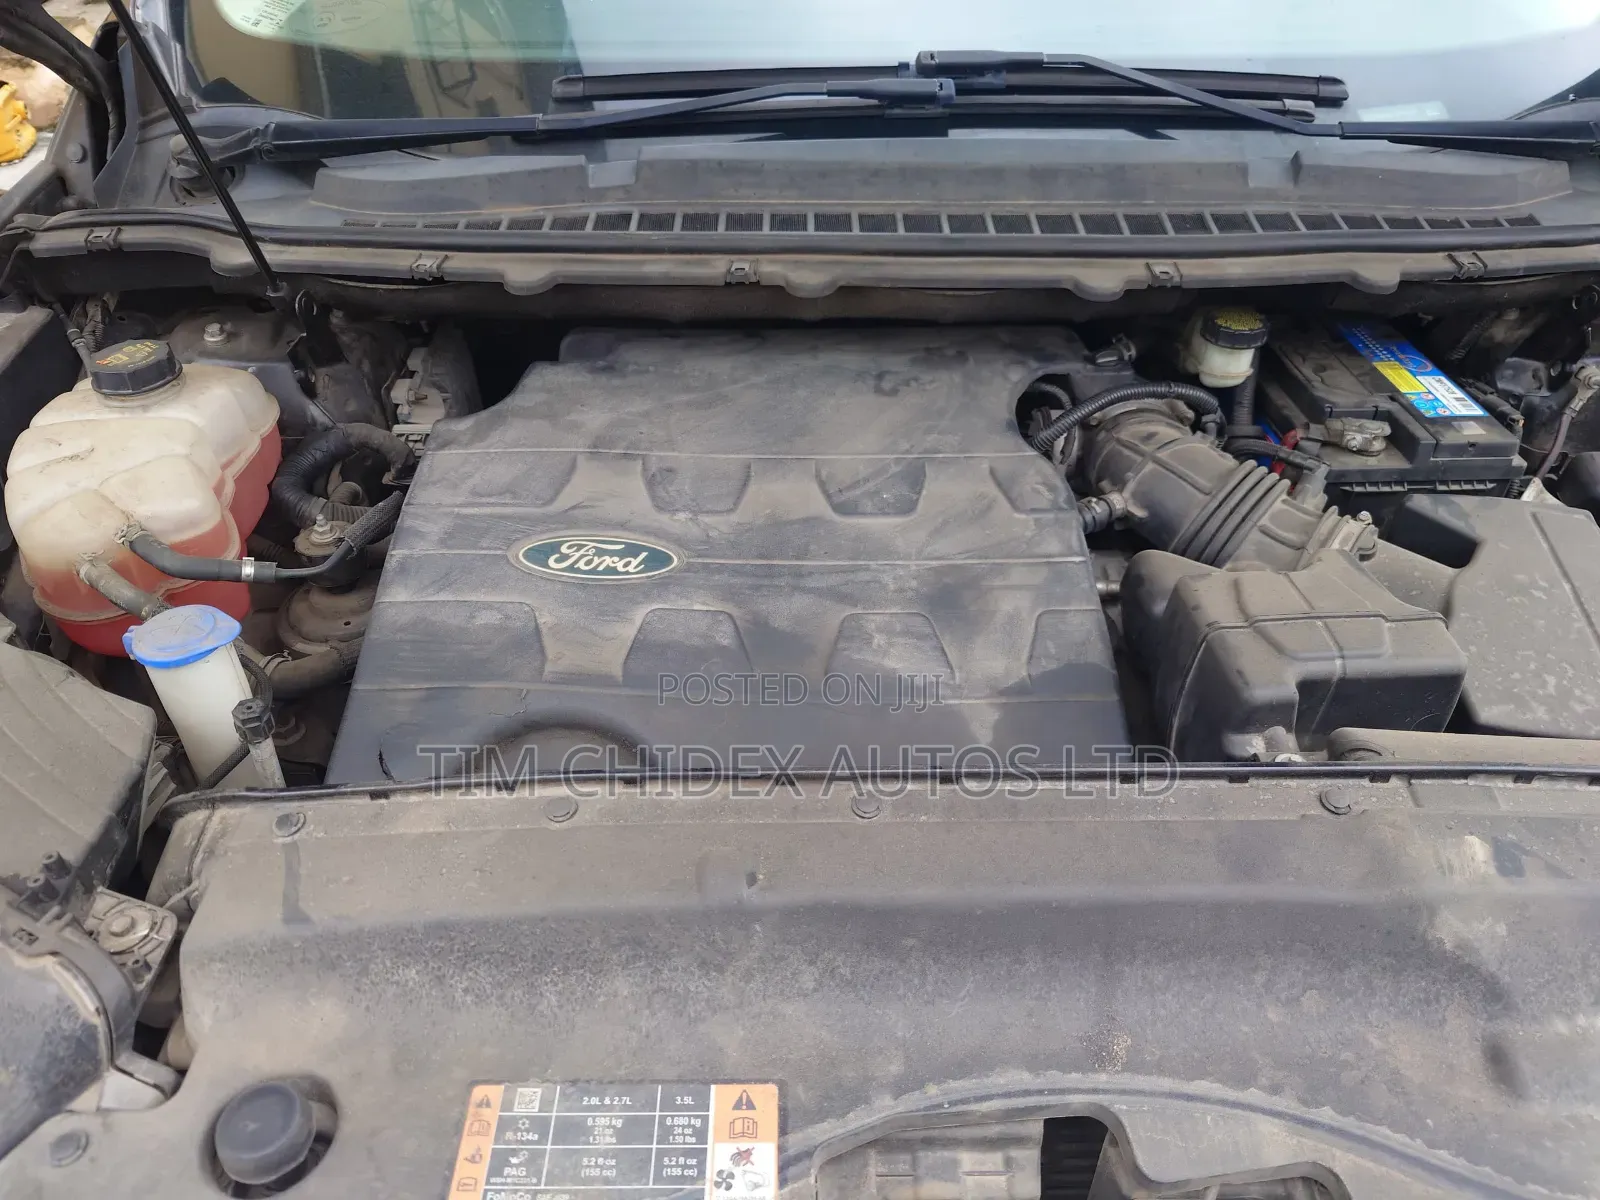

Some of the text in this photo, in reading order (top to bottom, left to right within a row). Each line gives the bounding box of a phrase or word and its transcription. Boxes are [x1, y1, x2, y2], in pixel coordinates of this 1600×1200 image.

[547, 540, 649, 573] Ford
[582, 1097, 632, 1105] 2.0L & 2.7L
[675, 1096, 695, 1105] 3.5L
[611, 1117, 623, 1128] kg
[665, 1117, 702, 1128] 0.680 kg
[582, 1157, 595, 1166] 5.2
[663, 1157, 677, 1165] 5.2
[503, 1167, 527, 1176] PAG
[581, 1168, 617, 1178] (155 cc)
[662, 1168, 698, 1178] (155 cc)
